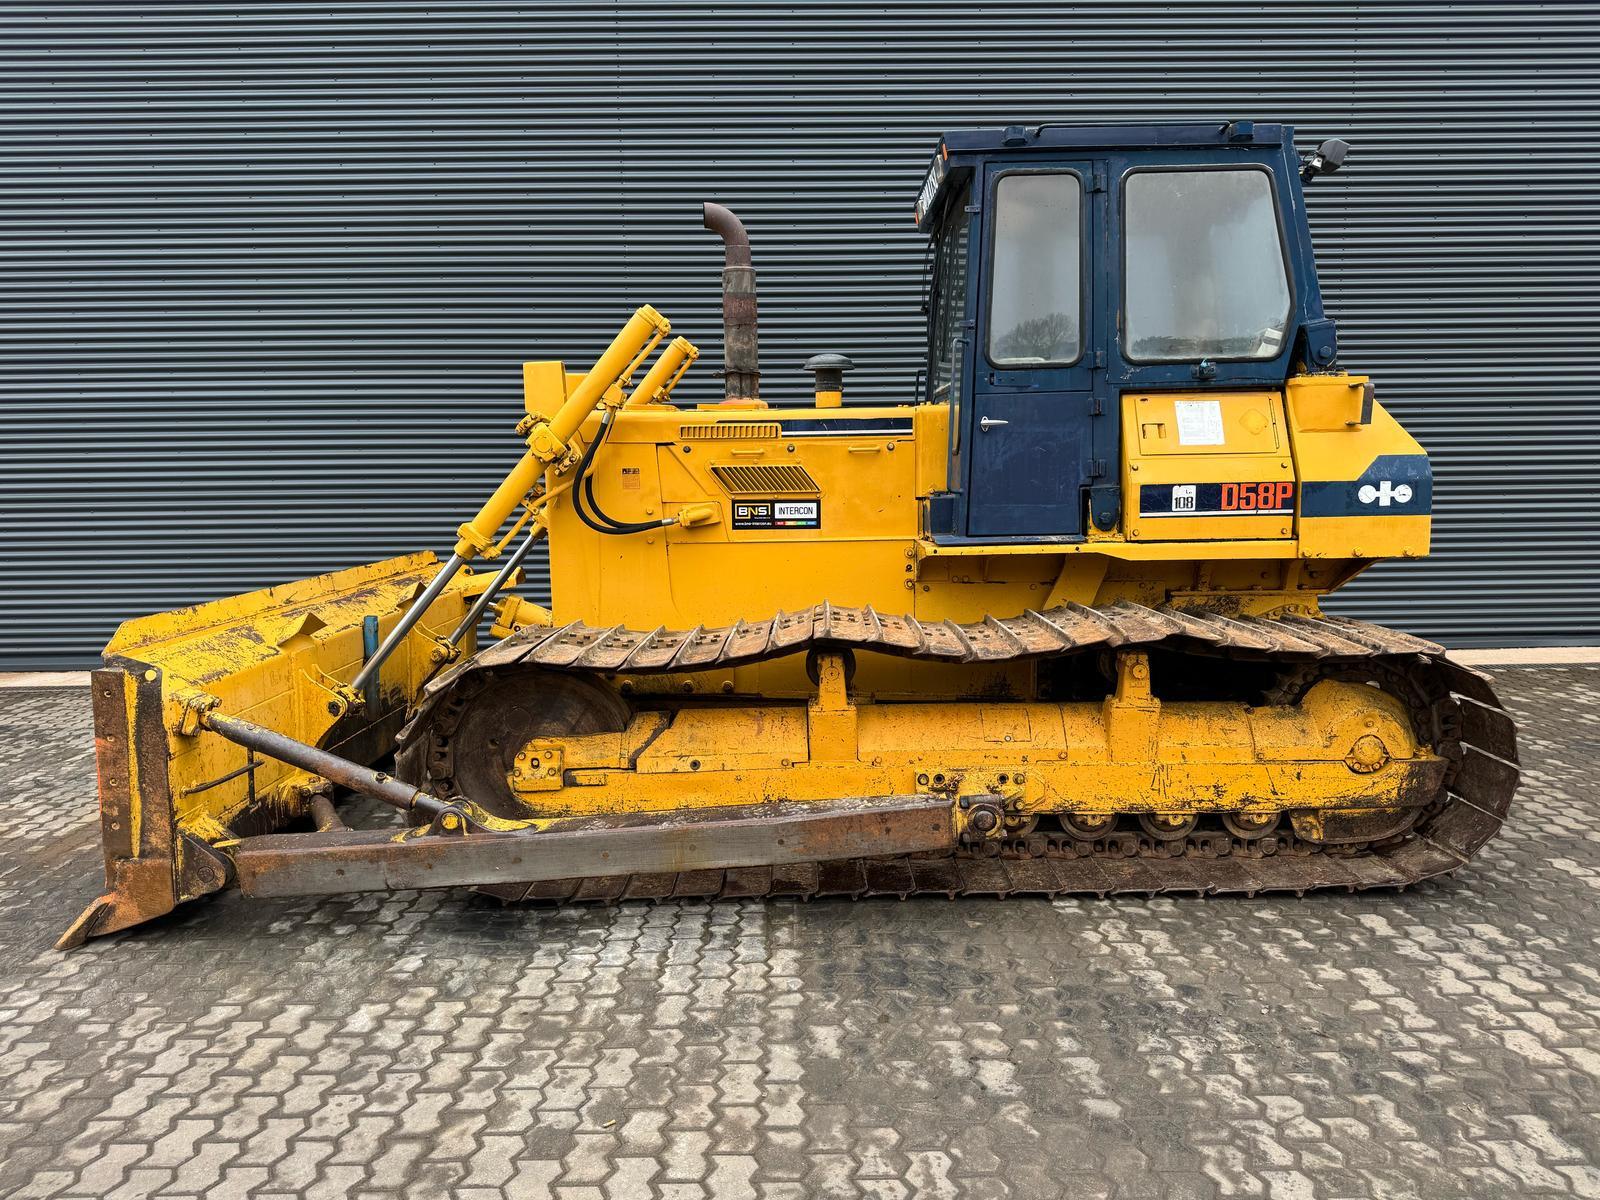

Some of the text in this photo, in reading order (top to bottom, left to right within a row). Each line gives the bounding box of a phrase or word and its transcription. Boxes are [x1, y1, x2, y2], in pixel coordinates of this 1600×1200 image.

[1221, 483, 1293, 510] D58P
[1174, 497, 1194, 509] 108
[738, 506, 768, 516] BNS
[778, 506, 814, 515] INTERCON
